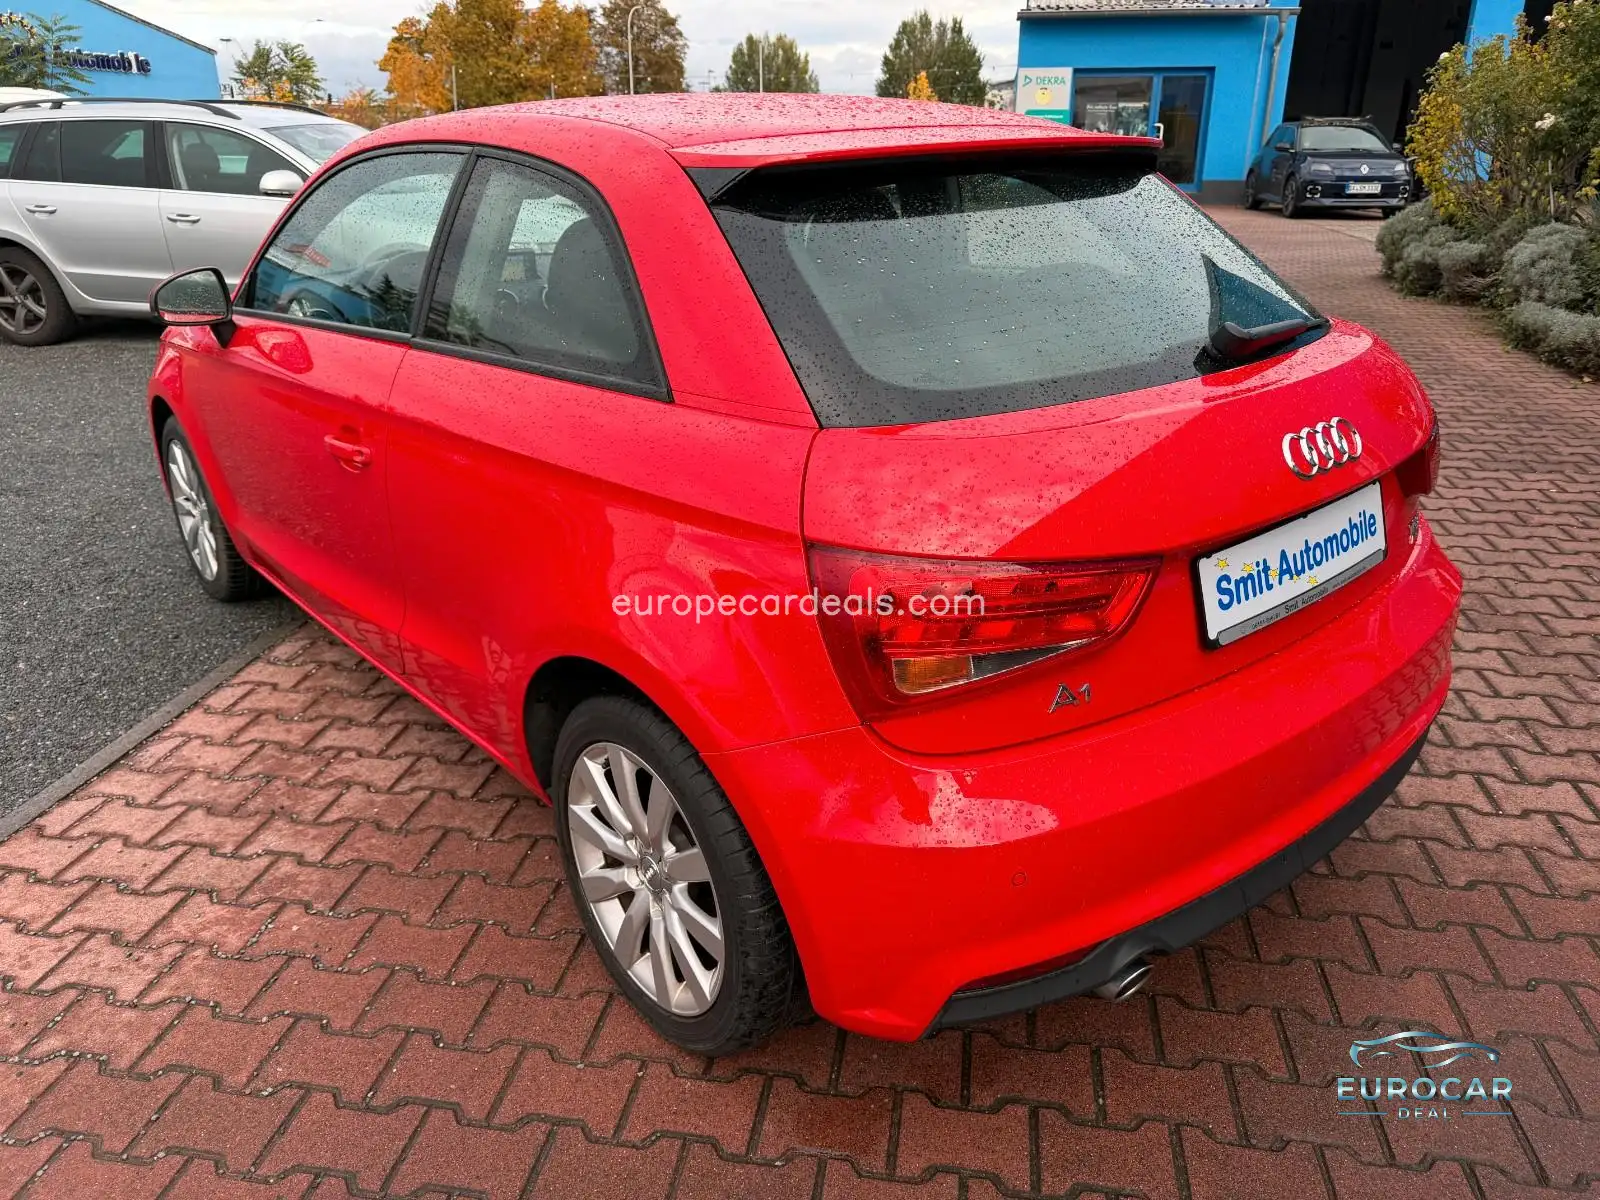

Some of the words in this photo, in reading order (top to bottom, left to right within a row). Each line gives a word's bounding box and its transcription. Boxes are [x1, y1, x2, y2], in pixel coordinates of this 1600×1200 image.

[1036, 76, 1066, 86] DEKRA
[1216, 558, 1274, 611] Smit
[1278, 509, 1377, 586] Automobile
[1047, 682, 1092, 714] A1
